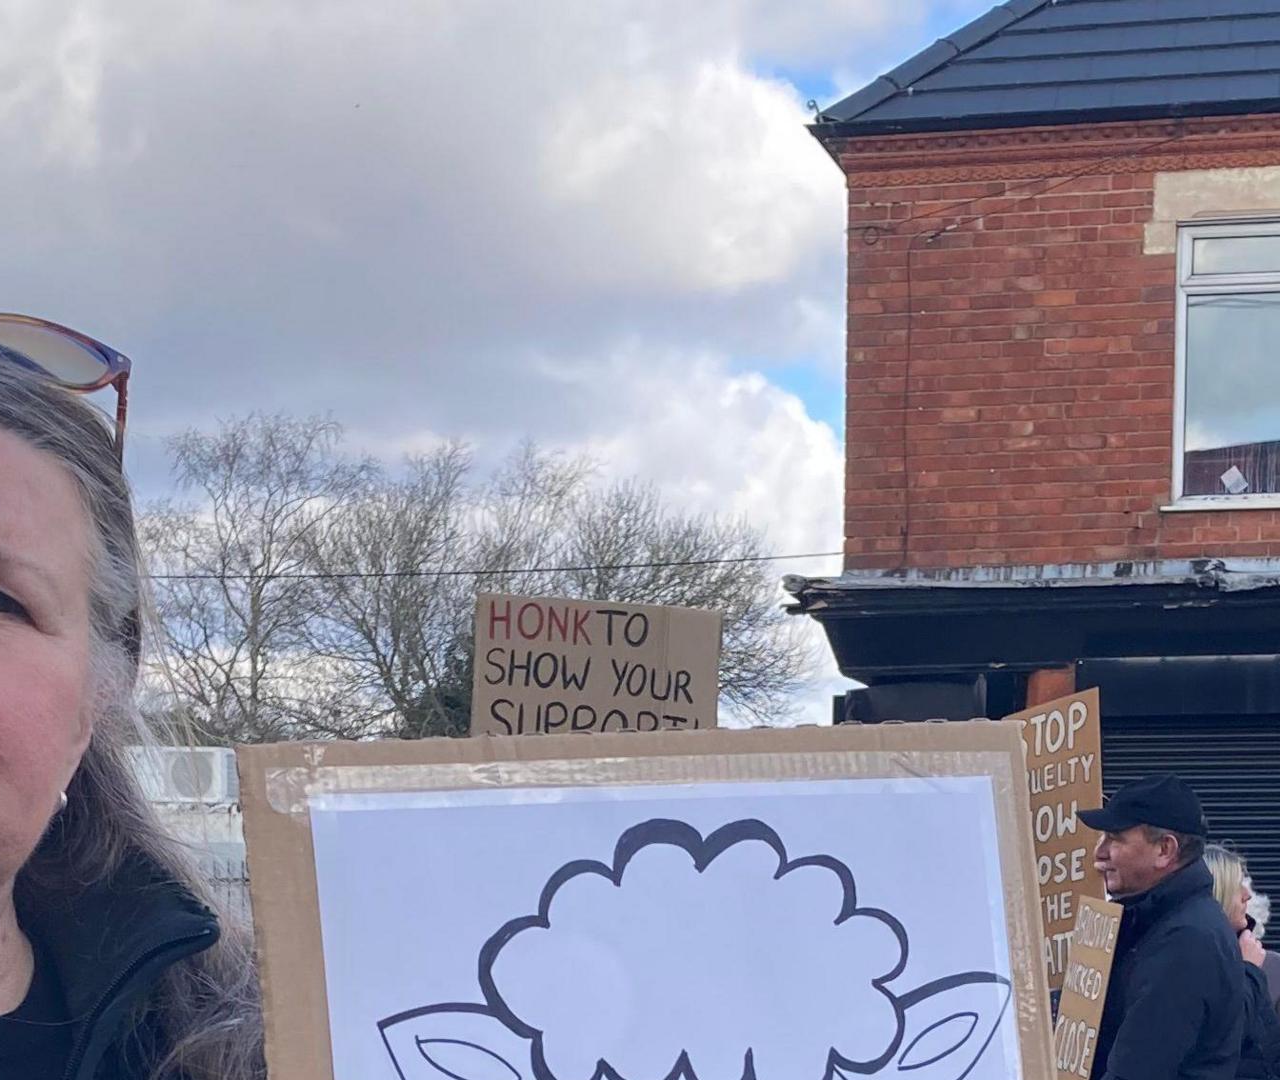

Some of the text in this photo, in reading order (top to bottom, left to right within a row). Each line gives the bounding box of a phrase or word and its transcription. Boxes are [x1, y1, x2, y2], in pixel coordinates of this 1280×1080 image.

[489, 600, 650, 648] HONK TO
[484, 647, 694, 704] SHOW YOUR
[1027, 754, 1094, 795] UELTY
[1036, 800, 1078, 842] OW
[1037, 848, 1087, 885] OSE
